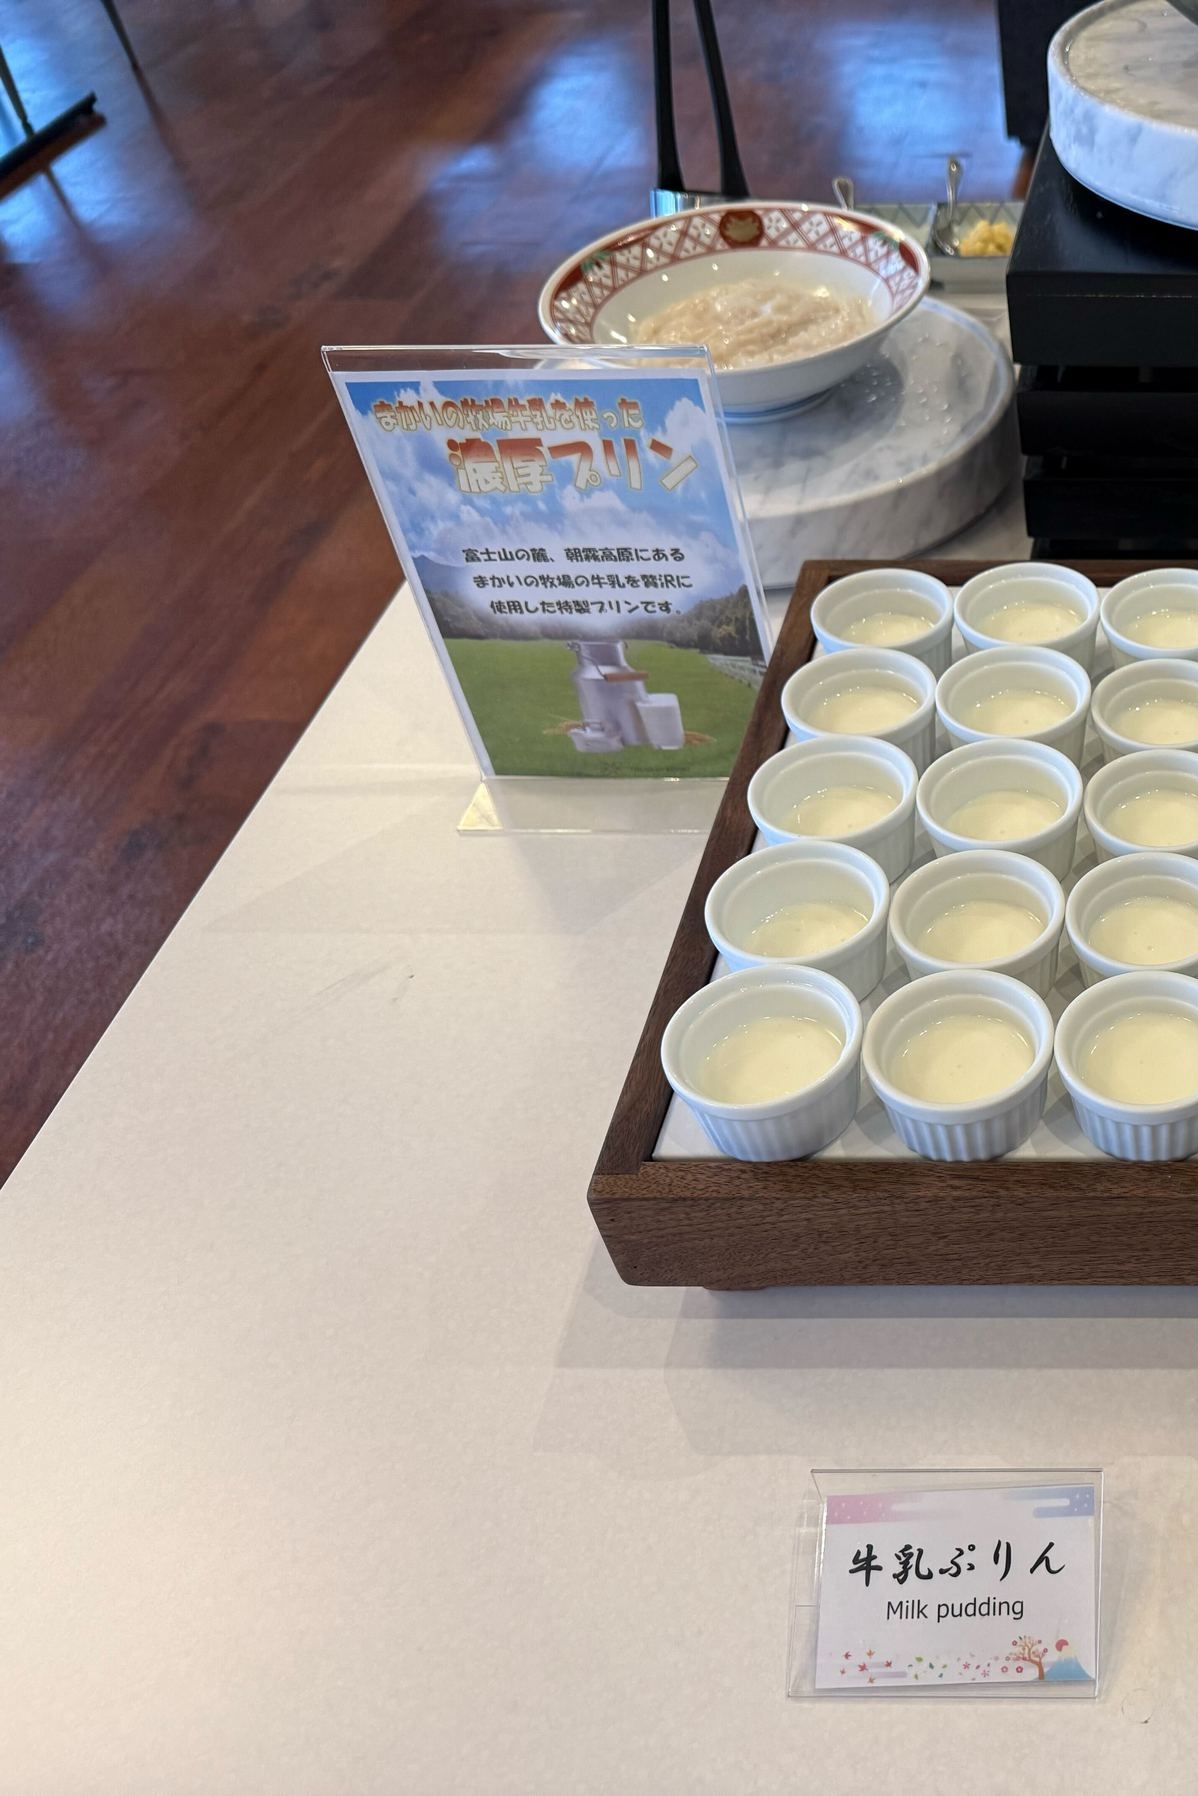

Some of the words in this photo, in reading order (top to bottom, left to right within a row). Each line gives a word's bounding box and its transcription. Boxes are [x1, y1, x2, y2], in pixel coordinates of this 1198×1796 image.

[373, 396, 643, 432] まかいの牧場牛乳を使った
[446, 437, 698, 494] 濃厚プリン
[462, 547, 685, 563] 富士山の麓、朝霧高原にある
[473, 574, 693, 590] まかいの牧場の牛乳を贅沢に
[490, 599, 682, 615] 使用した特製プリンです。
[849, 1540, 1066, 1587] 牛乳ぷりん
[886, 1600, 928, 1620] Milk
[937, 1597, 1024, 1623] pudding
